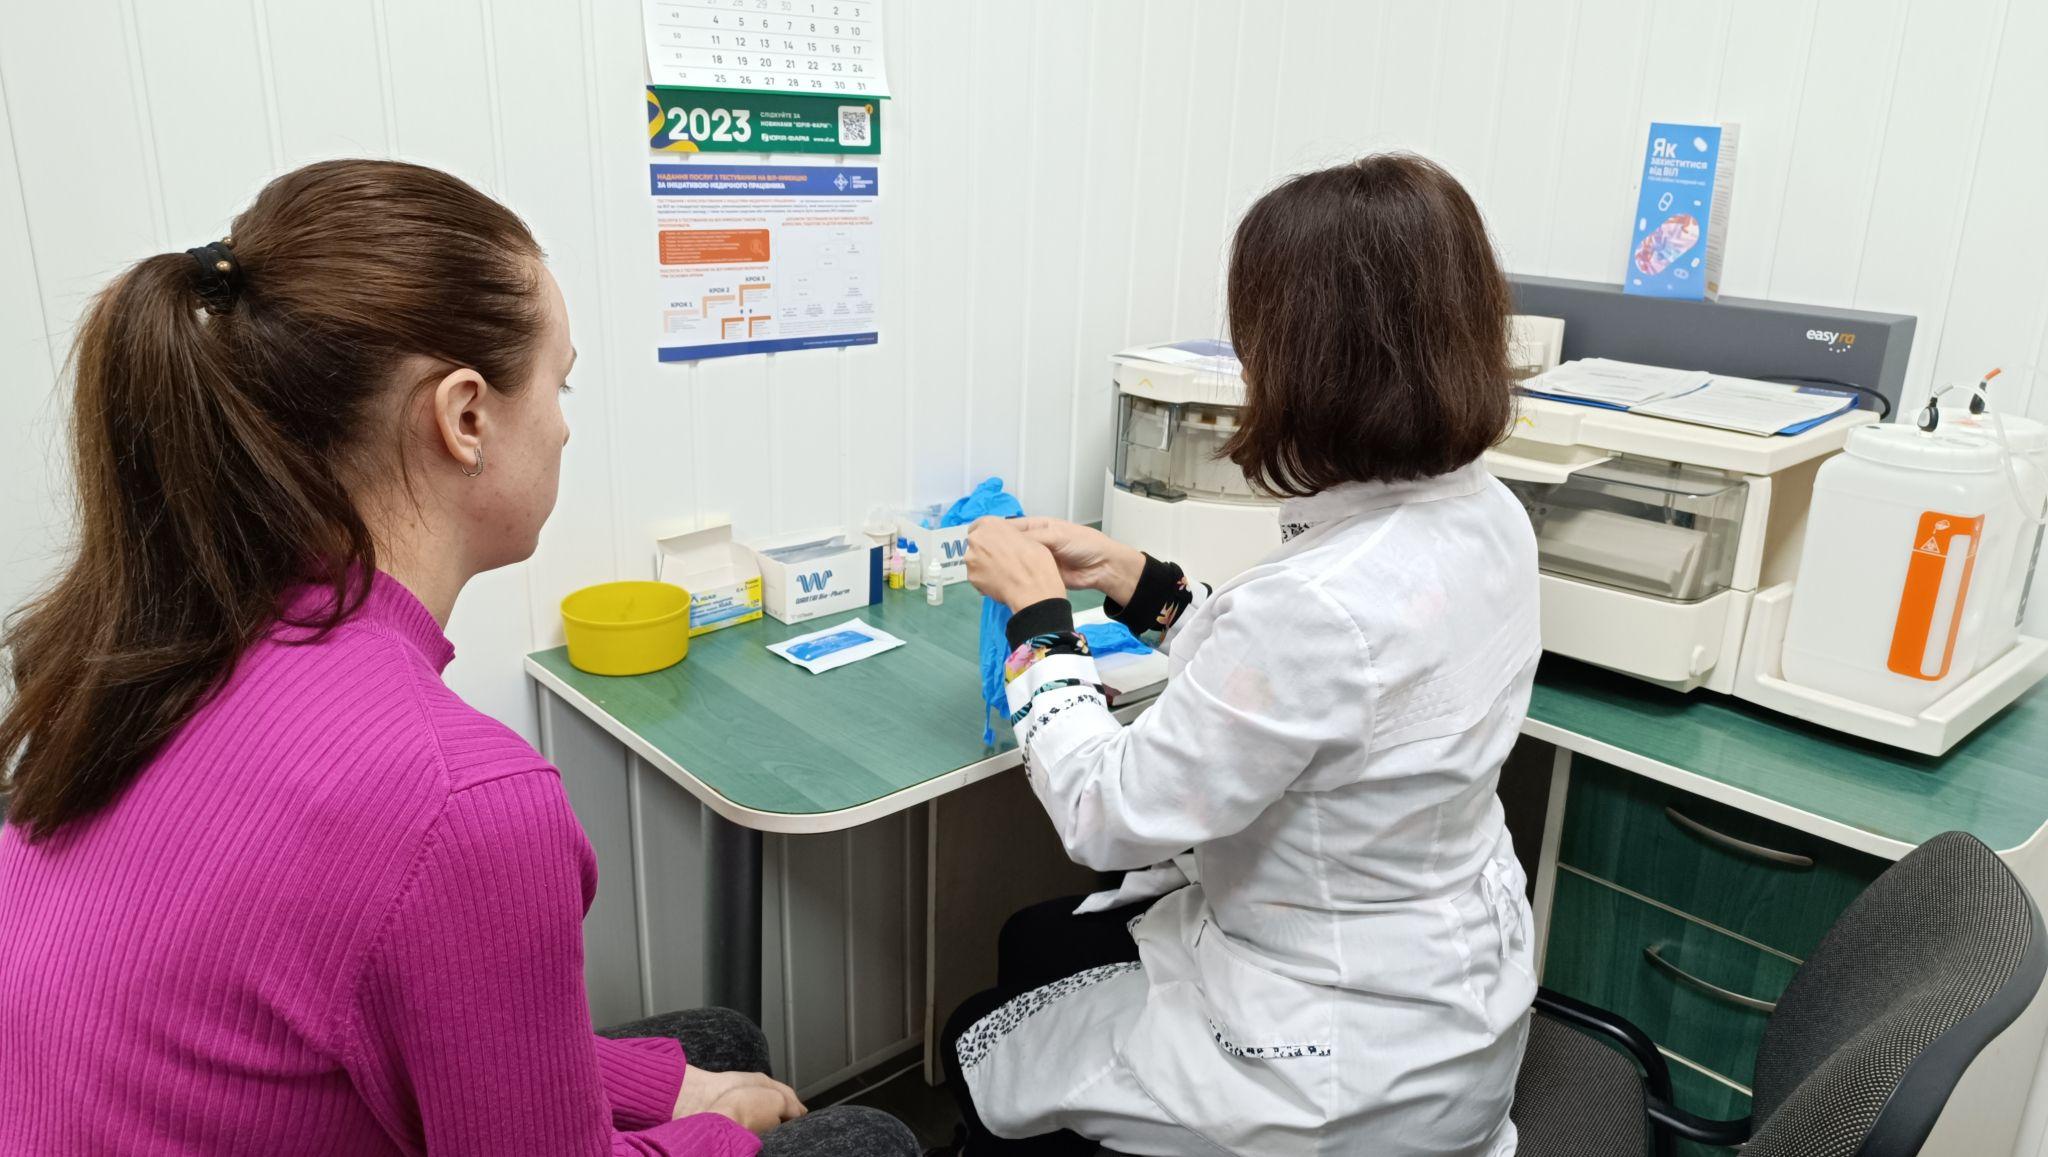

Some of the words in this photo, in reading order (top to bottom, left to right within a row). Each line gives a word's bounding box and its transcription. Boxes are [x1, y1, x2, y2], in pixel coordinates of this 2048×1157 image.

[810, 4, 815, 13] 1
[833, 6, 839, 15] 2
[855, 8, 860, 17] 3
[713, 15, 719, 24] 4
[738, 17, 744, 26] 5
[762, 19, 768, 28] 6
[787, 21, 793, 30] 7
[810, 23, 816, 32] 8
[834, 25, 840, 34] 9
[850, 27, 861, 36] 10
[711, 35, 721, 45] 11
[735, 37, 746, 47] 12
[760, 39, 770, 48] 13
[783, 40, 794, 50] 14
[807, 42, 817, 52] 15
[830, 44, 841, 54] 16
[852, 45, 861, 54] 17
[712, 55, 723, 64] 18
[737, 56, 748, 66] 19
[760, 58, 772, 67] 20
[786, 59, 796, 69] 21
[808, 61, 819, 70] 22
[832, 63, 842, 72] 23
[853, 64, 863, 73] 24
[714, 74, 727, 83] 25
[739, 75, 752, 84] 26
[764, 77, 775, 85] 27
[787, 78, 799, 87] 28
[810, 80, 822, 88] 29
[835, 81, 846, 90] 30
[857, 82, 866, 90] 31
[667, 106, 752, 142] 2023
[1652, 137, 1678, 159] Як
